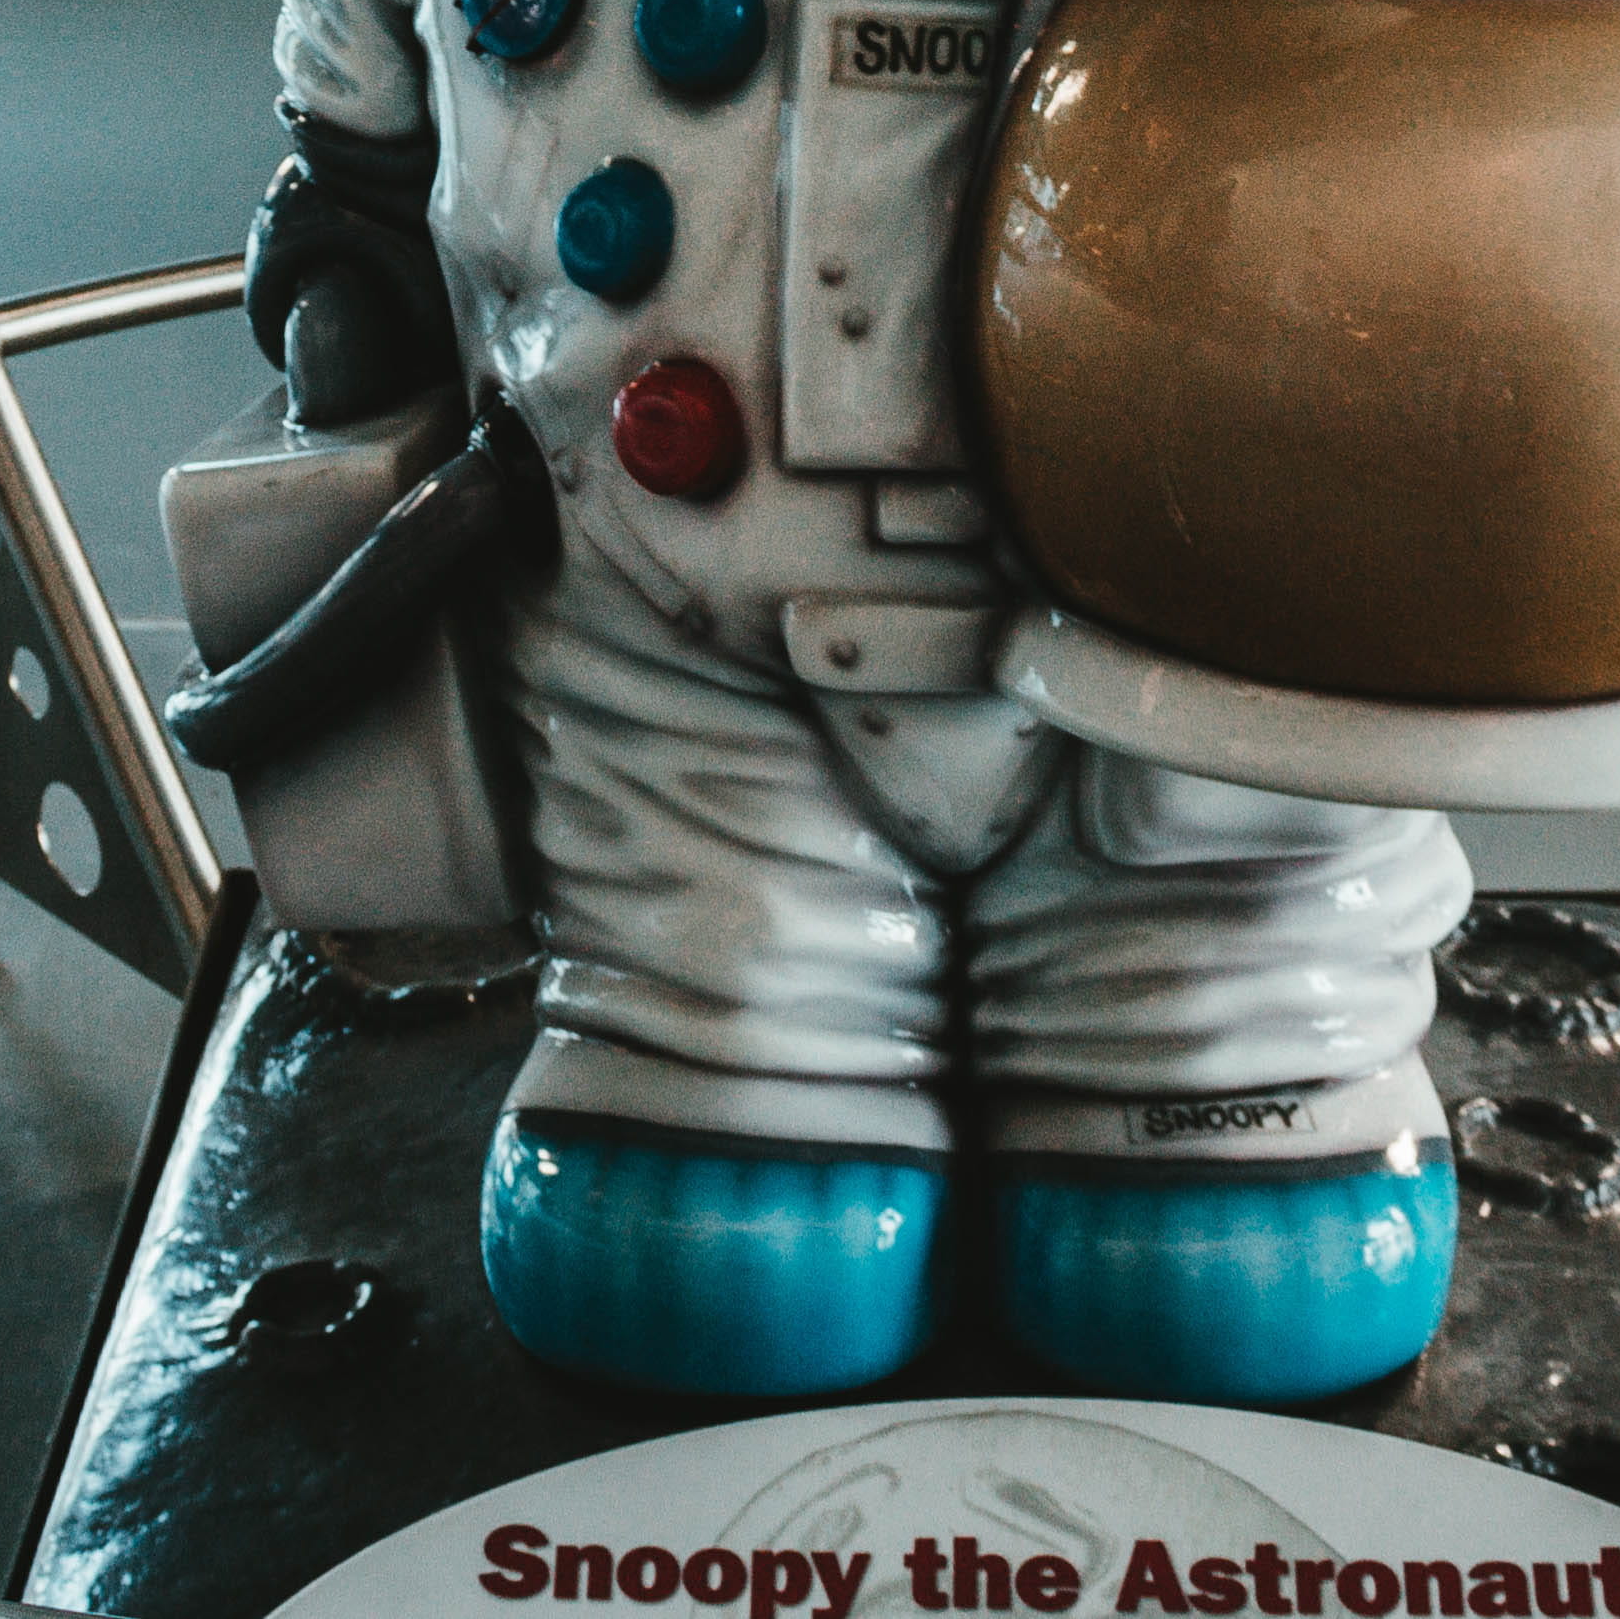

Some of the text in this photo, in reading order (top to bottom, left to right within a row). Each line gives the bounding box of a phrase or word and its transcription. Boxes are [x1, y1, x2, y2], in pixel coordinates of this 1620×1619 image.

[854, 19, 987, 76] SNOO
[1144, 1100, 1299, 1137] SNOOPY
[479, 1523, 872, 1619] Snoopy
[904, 1536, 1080, 1612] the
